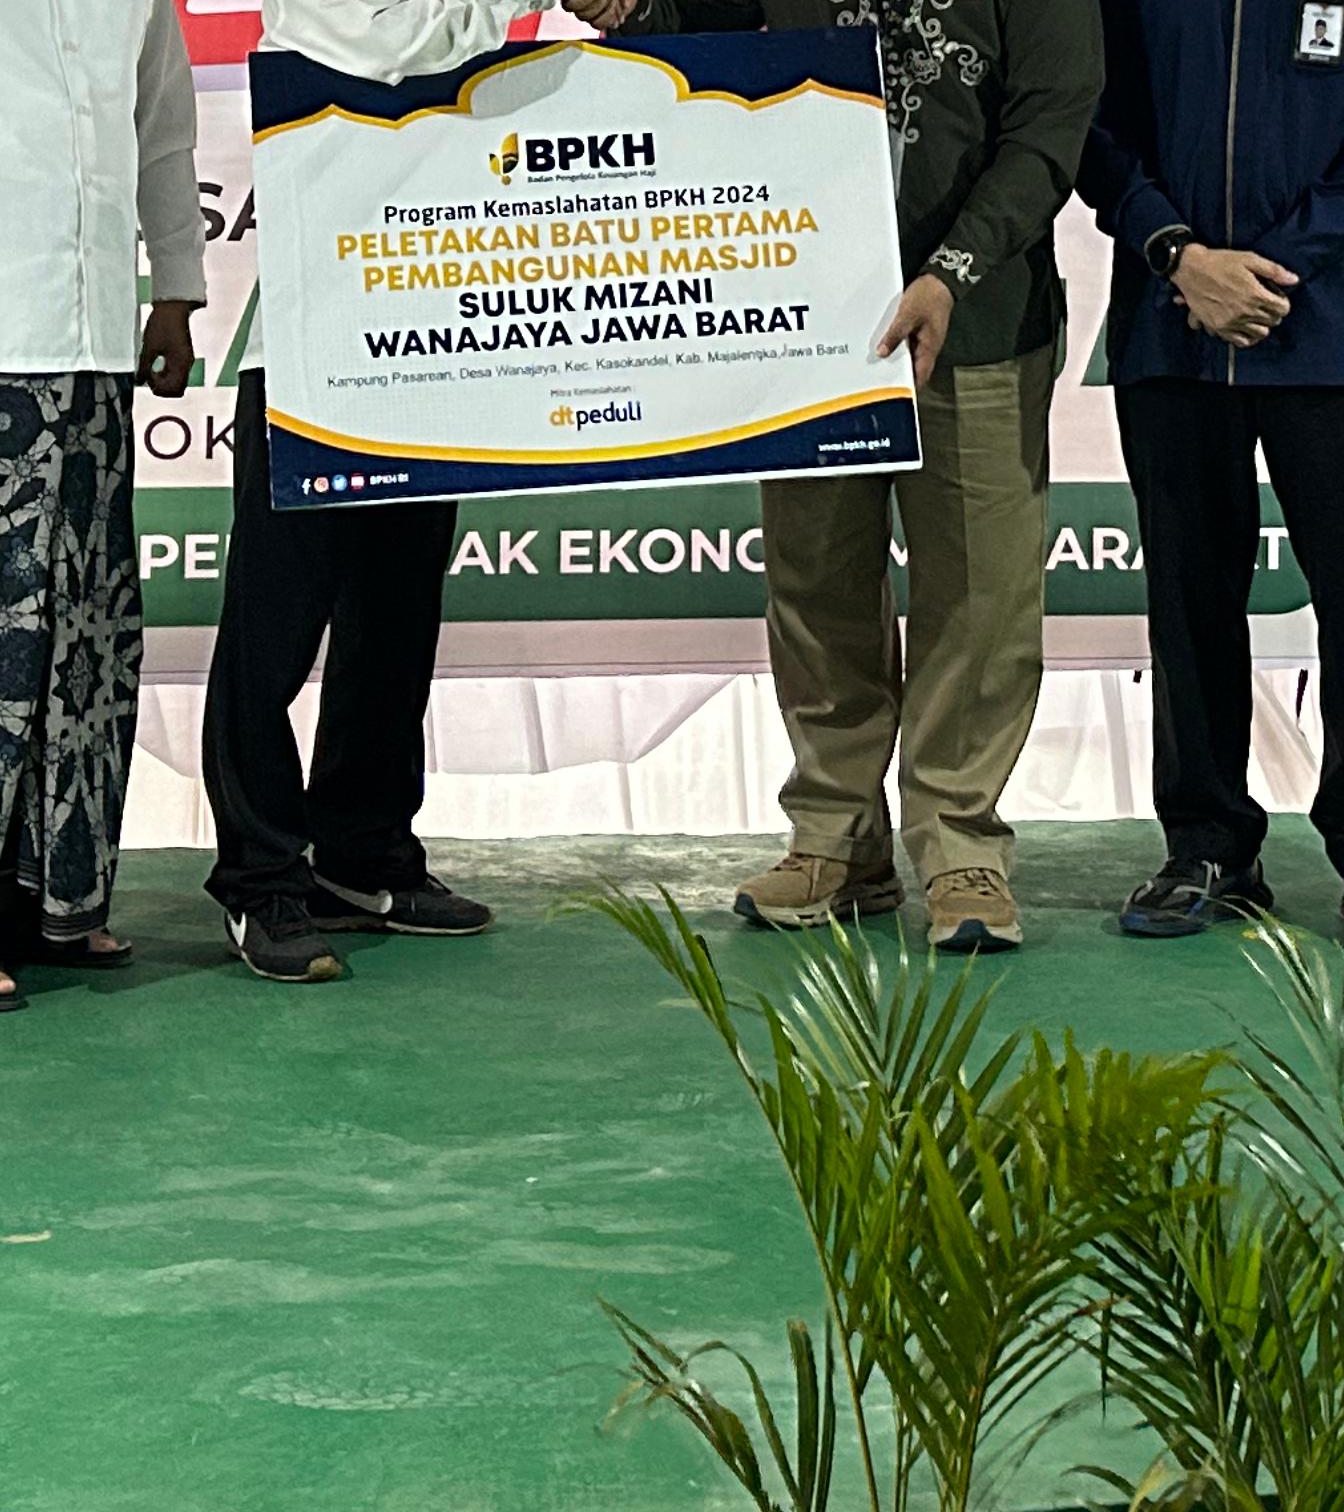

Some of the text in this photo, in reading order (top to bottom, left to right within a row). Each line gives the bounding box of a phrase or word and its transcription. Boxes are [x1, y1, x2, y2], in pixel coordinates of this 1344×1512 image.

[525, 132, 655, 173] BPKH
[384, 184, 770, 227] Program Kemaslahatan BPKH 2024
[337, 207, 820, 261] PELETAKAN BATU PERTAMA
[363, 241, 798, 293] PEMBANGUNAN MASJID
[459, 277, 714, 319] SULUK MIZANI
[363, 304, 810, 359] WANAJAYA JAWA BARAT
[327, 371, 388, 389] Kampung
[459, 365, 492, 381] Desa
[495, 361, 560, 379] Wanajaya,
[564, 358, 592, 373] Kec.
[596, 353, 671, 371] Kasokandel,
[675, 351, 704, 365] Kab.
[816, 343, 850, 356] Barat
